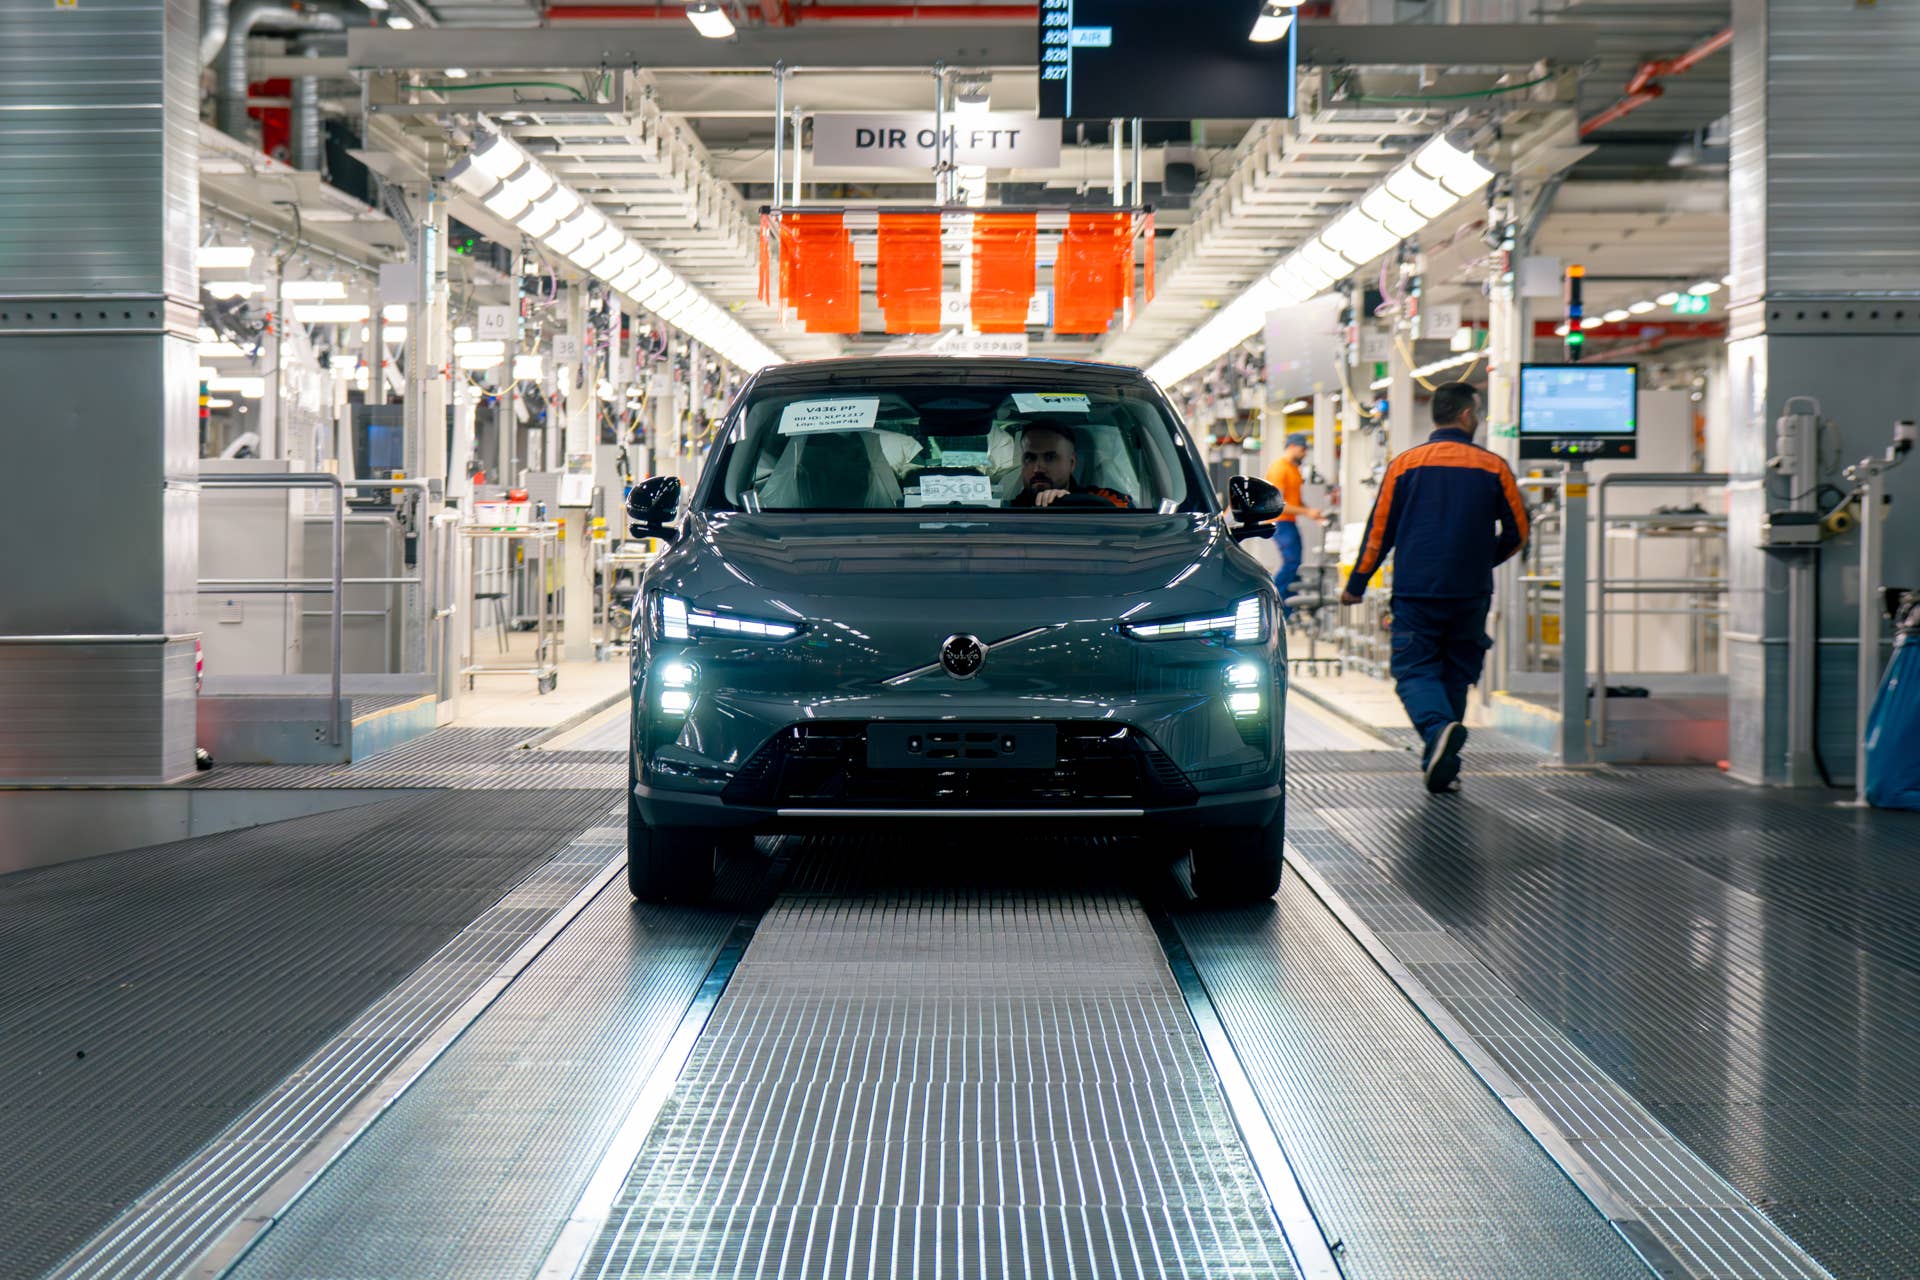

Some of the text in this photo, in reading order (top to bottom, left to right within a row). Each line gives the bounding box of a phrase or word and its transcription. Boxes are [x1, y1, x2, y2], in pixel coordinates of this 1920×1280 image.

[1042, 13, 1068, 26] .830
[1042, 31, 1102, 44] .829 AIR
[1041, 66, 1067, 80] .827
[855, 128, 1020, 149] DIR OK FTT
[485, 314, 505, 328] 40
[973, 342, 1023, 352] REPAIR
